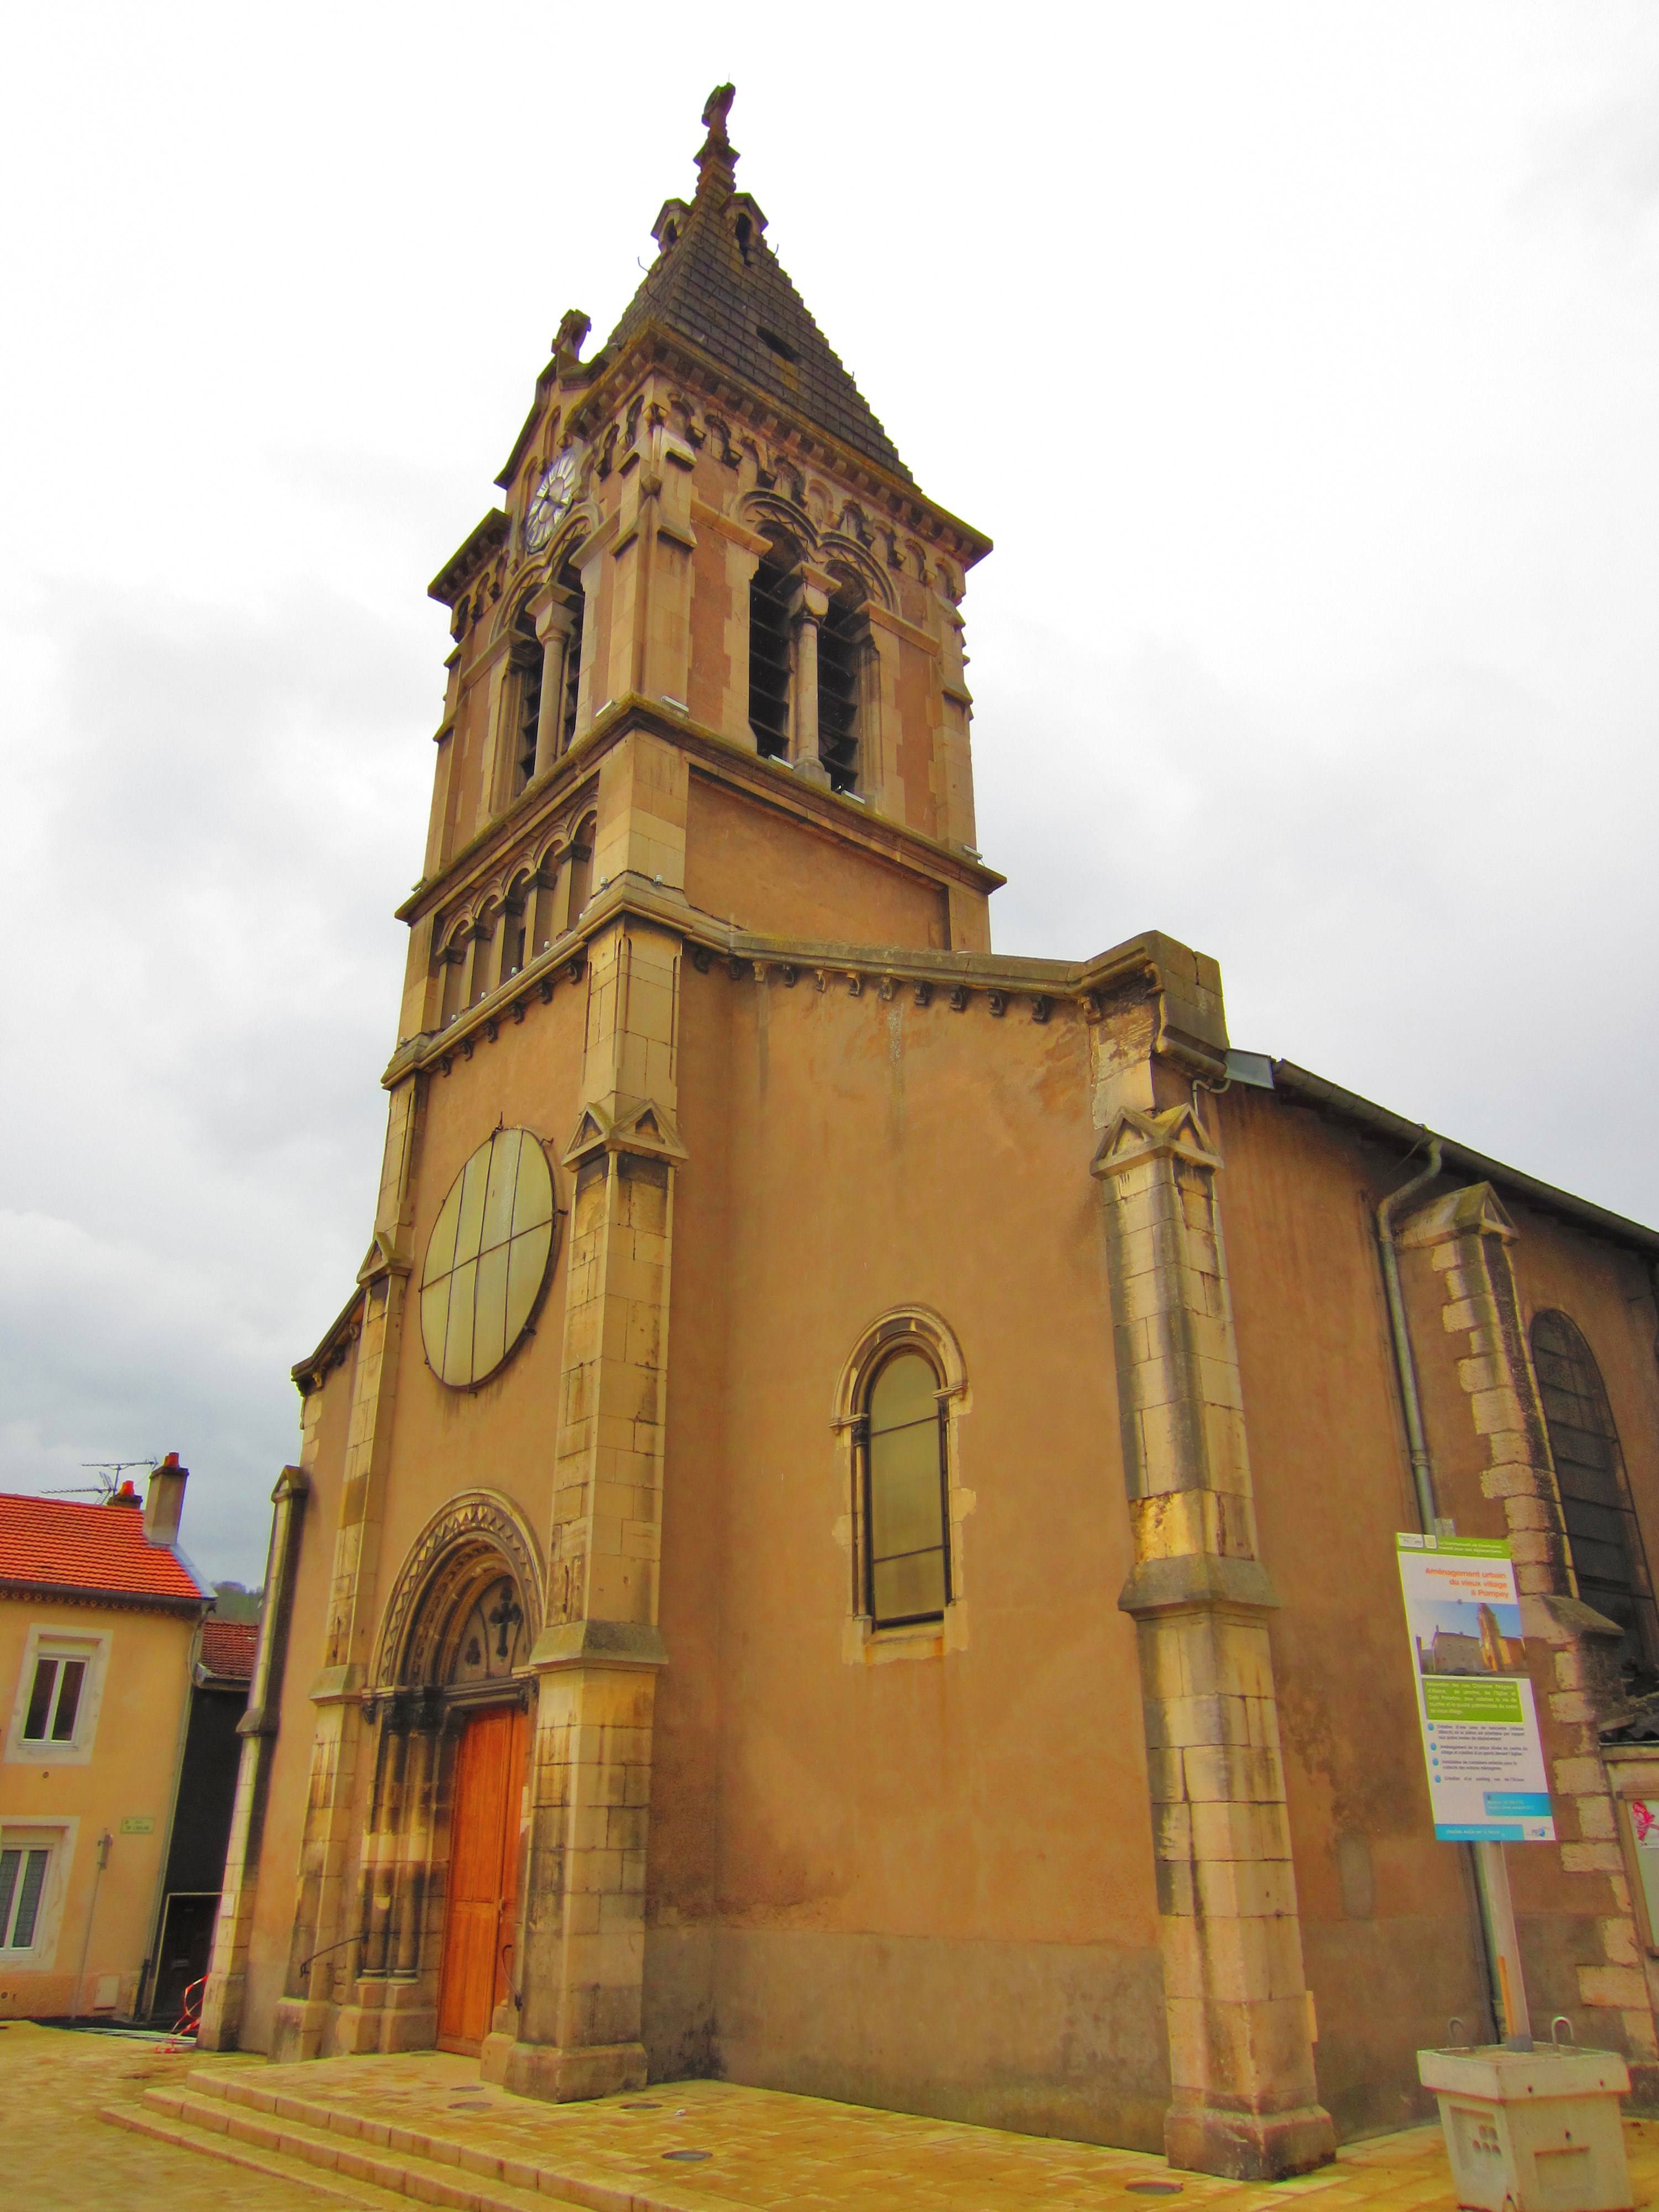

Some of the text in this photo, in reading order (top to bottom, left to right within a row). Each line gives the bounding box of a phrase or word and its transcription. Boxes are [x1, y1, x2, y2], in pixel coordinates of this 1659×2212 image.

[1425, 1568, 1506, 1579] Aménagement urbain
[1478, 1590, 1509, 1598] Pompey
